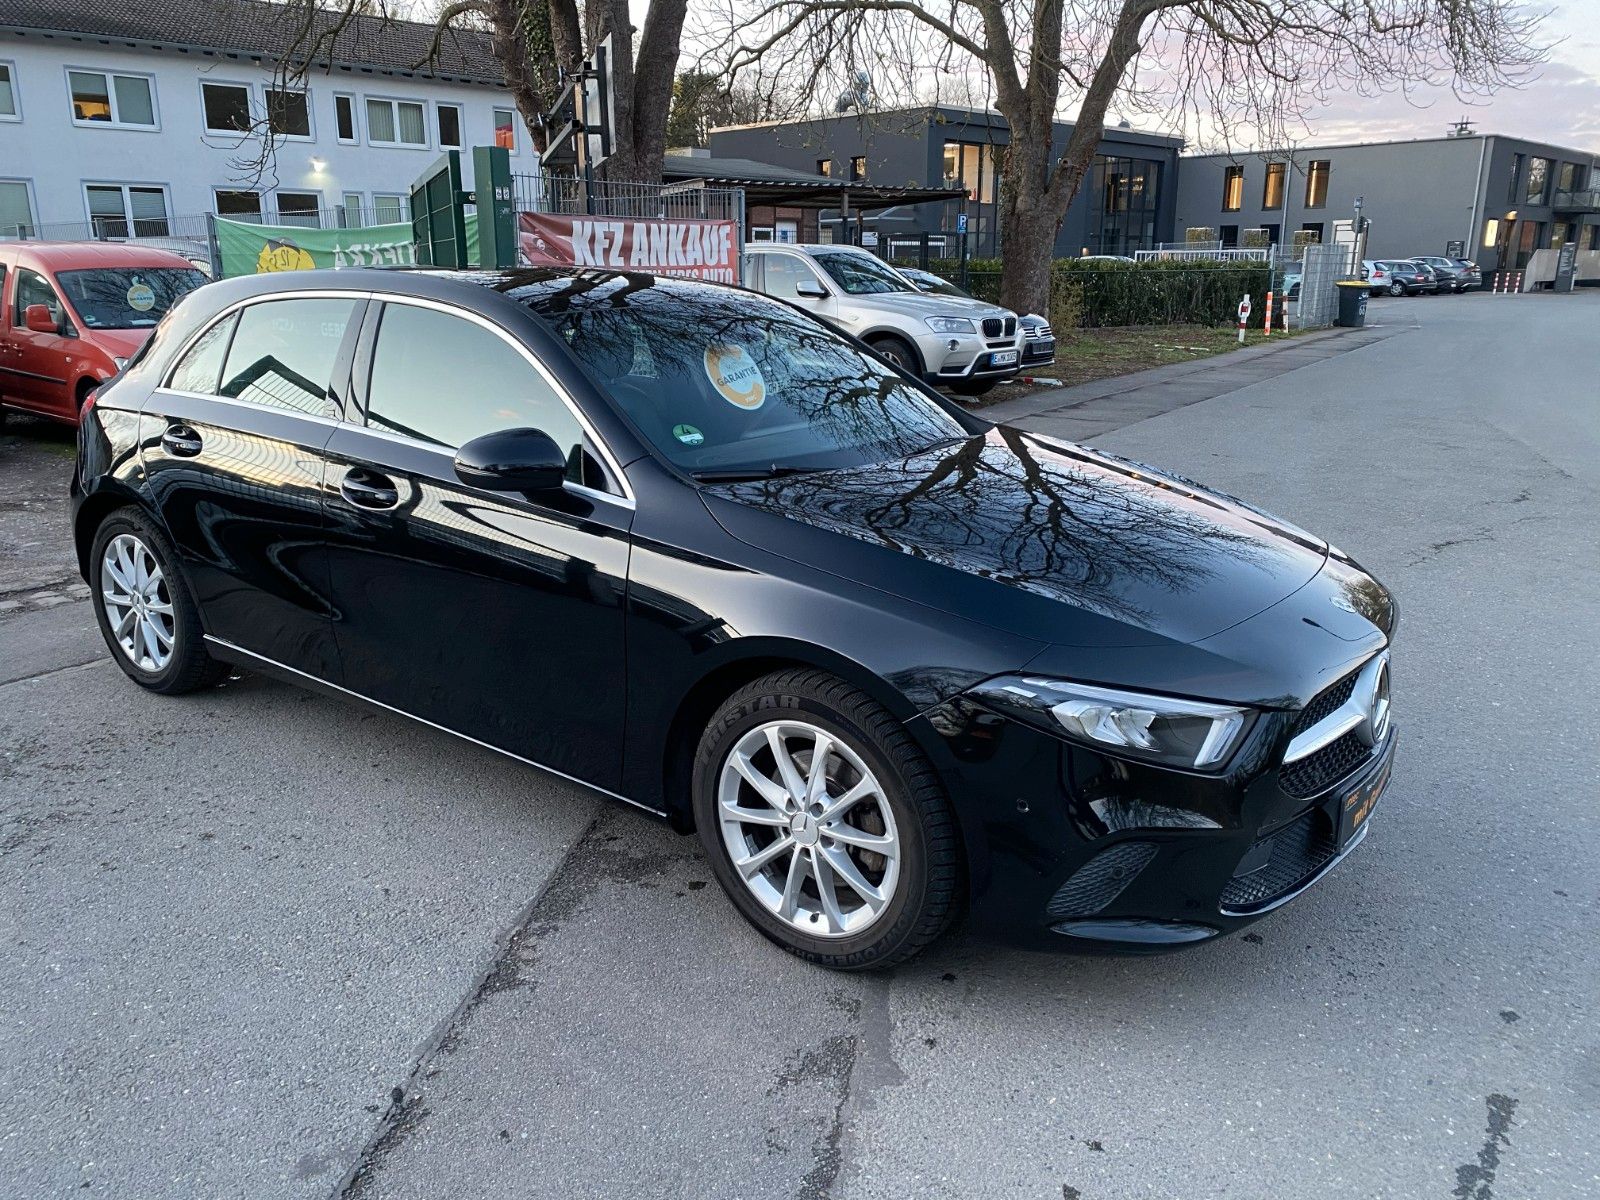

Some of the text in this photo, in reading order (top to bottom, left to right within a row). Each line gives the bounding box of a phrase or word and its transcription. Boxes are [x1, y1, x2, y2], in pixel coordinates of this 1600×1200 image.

[959, 216, 967, 226] P
[572, 221, 731, 266] KFZ ANKAUF
[717, 367, 757, 386] GARANTIE
